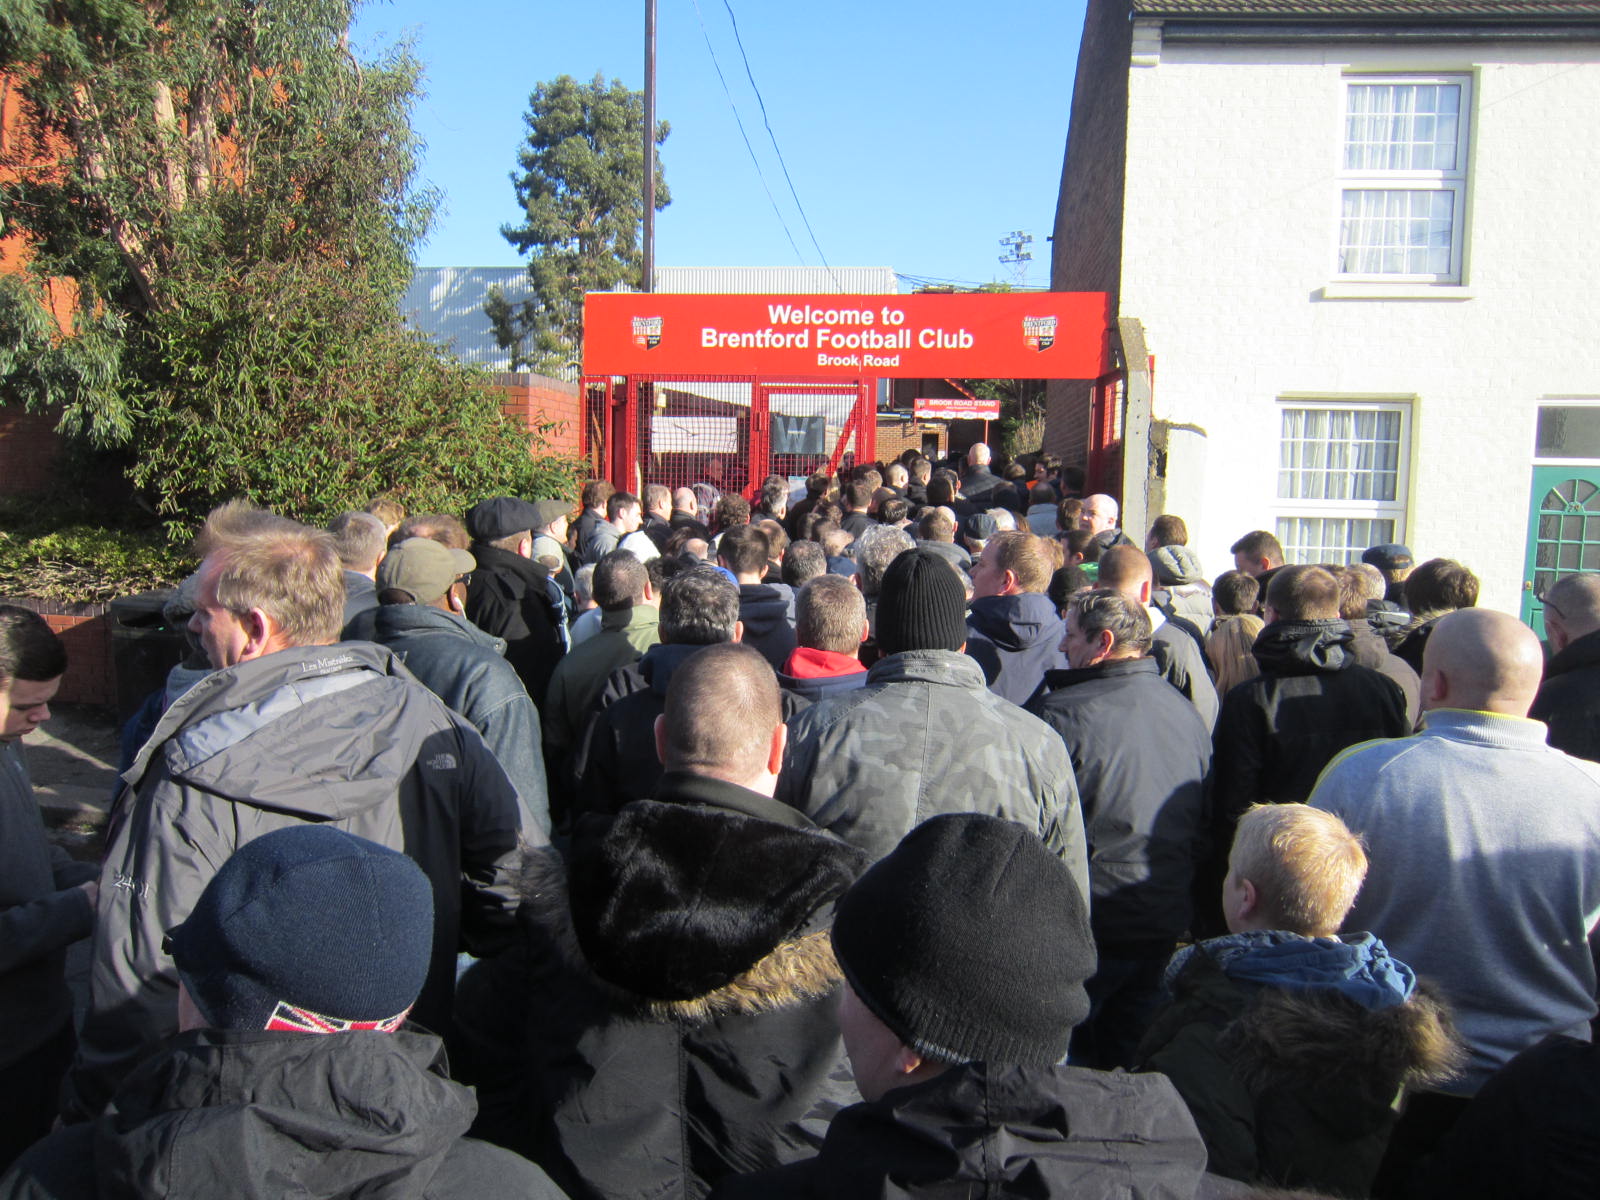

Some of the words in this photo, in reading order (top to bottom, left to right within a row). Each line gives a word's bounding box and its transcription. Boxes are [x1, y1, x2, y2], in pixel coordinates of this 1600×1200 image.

[768, 304, 874, 325] Welcome
[881, 306, 905, 325] to
[701, 328, 809, 348] Brentford
[816, 328, 911, 349] Football
[918, 328, 974, 349] Club
[817, 353, 859, 366] Brook
[863, 354, 900, 367] Road
